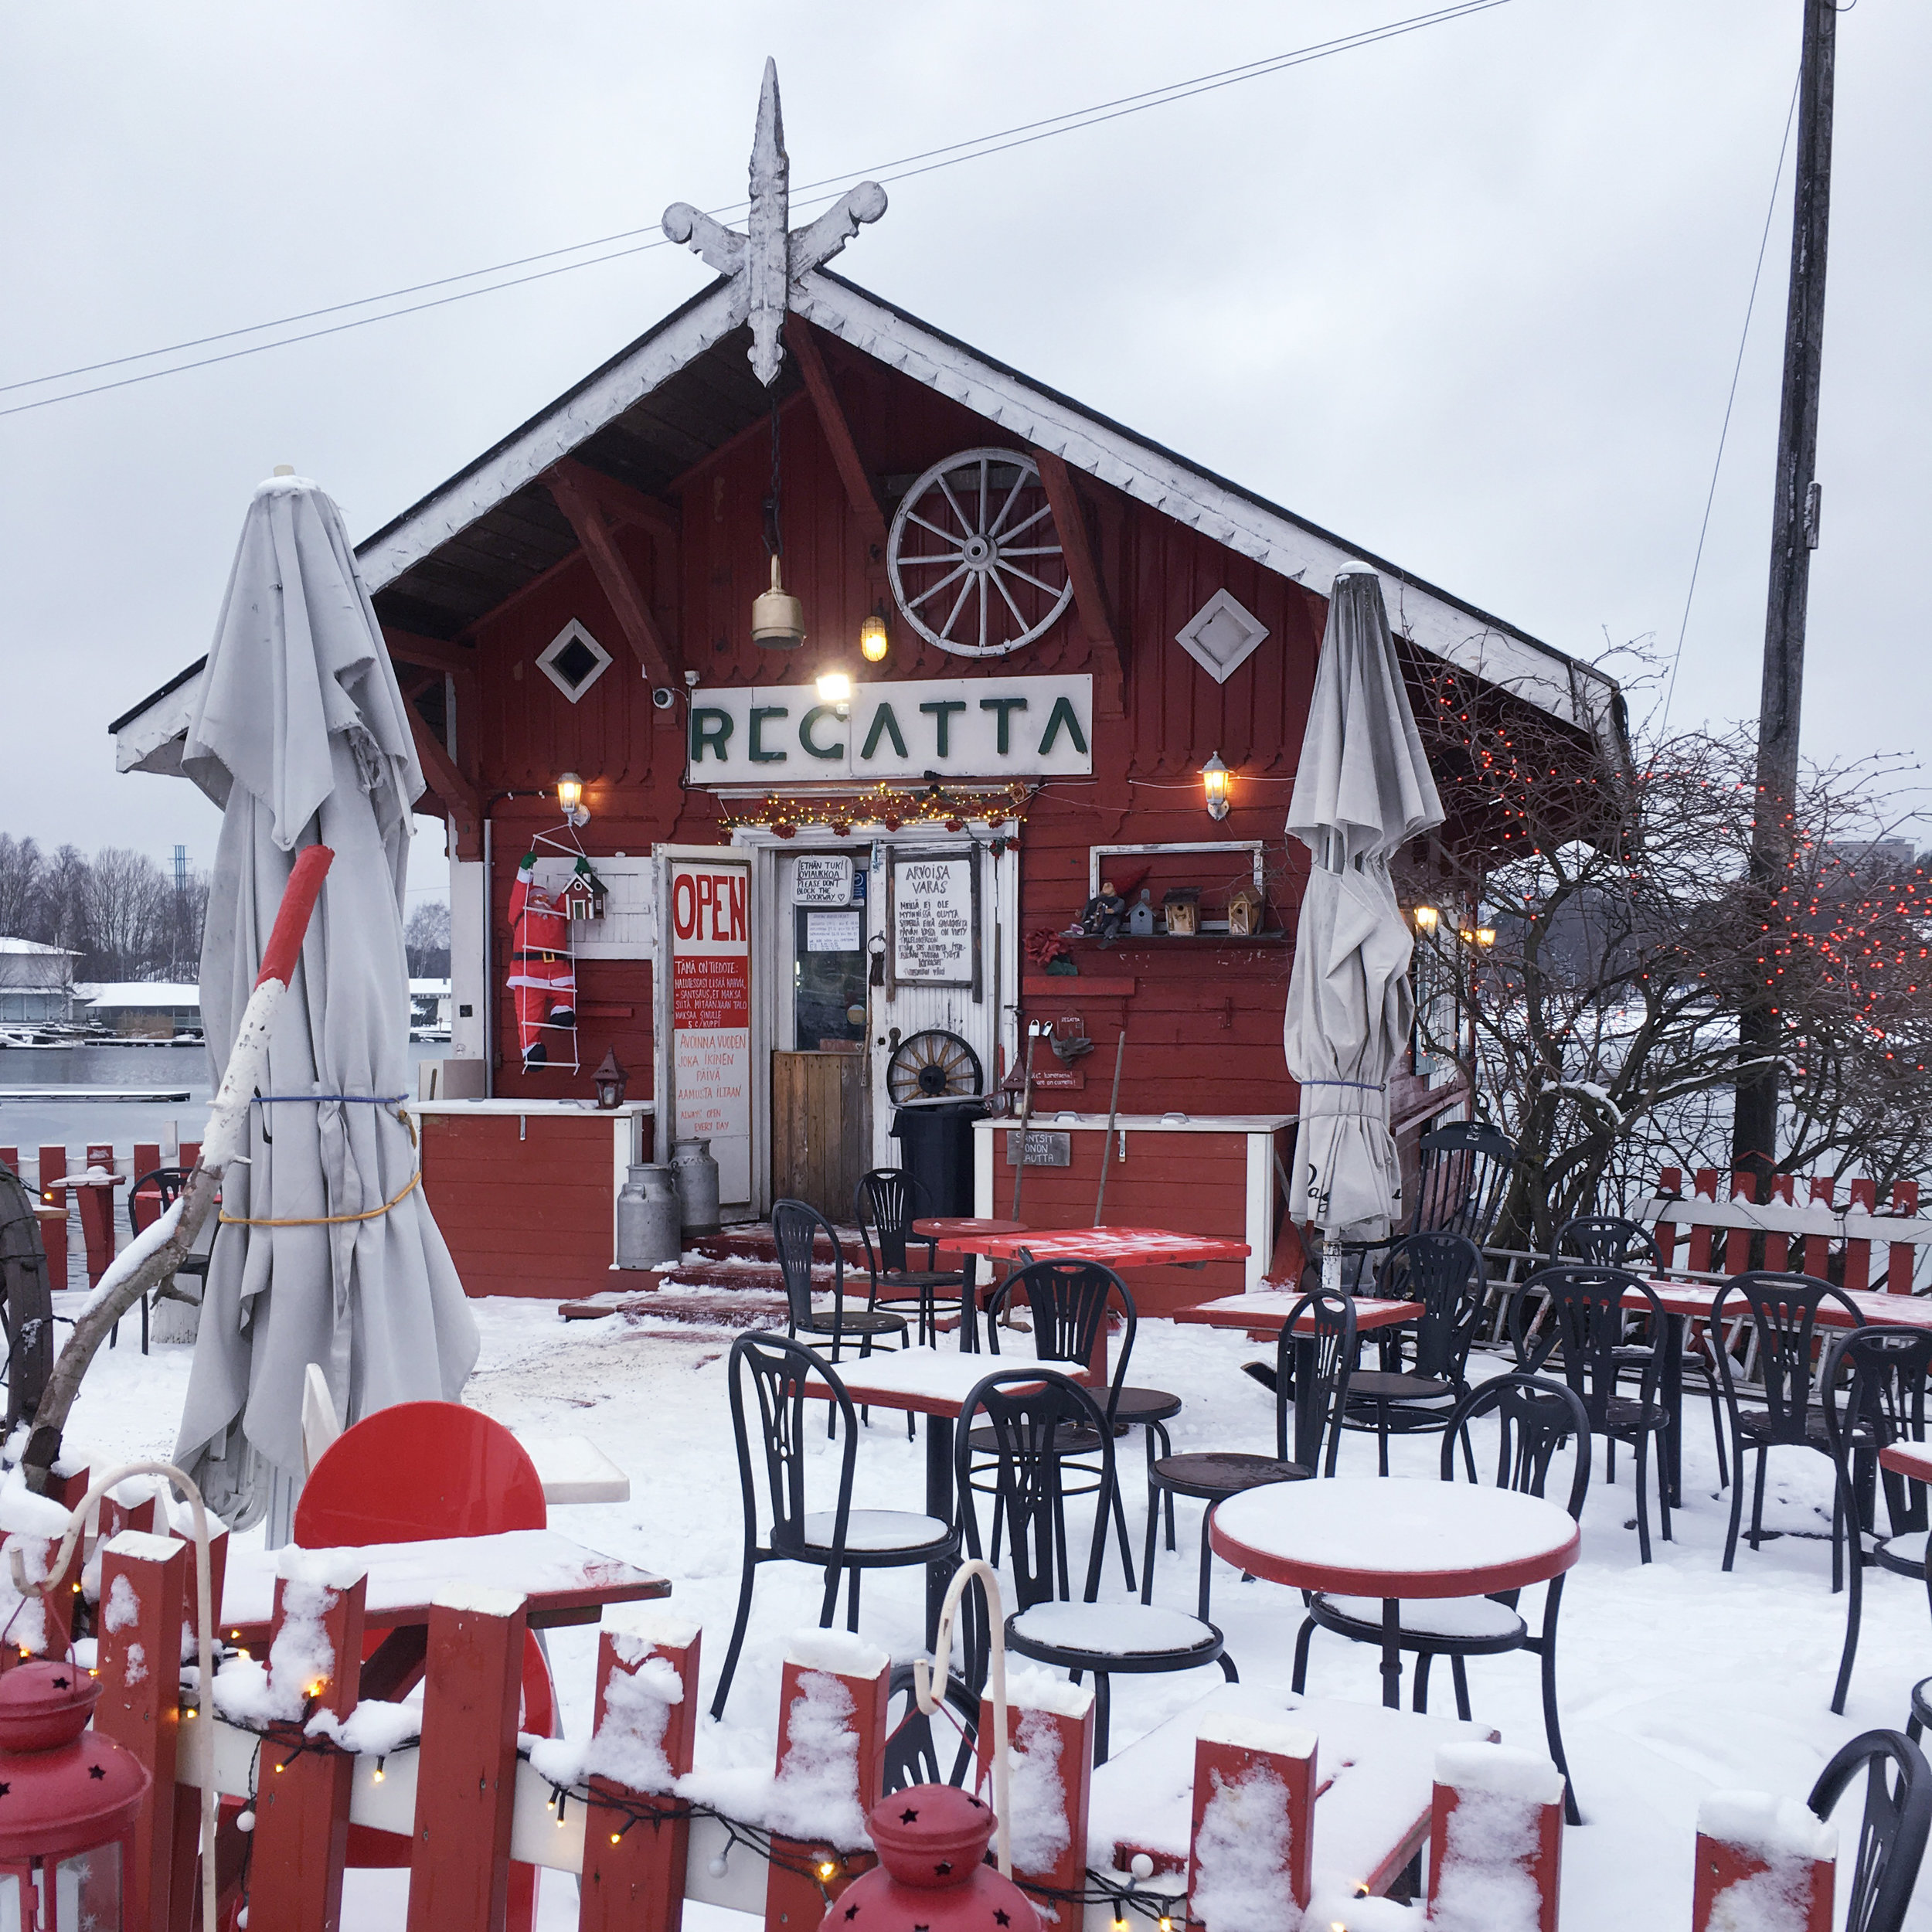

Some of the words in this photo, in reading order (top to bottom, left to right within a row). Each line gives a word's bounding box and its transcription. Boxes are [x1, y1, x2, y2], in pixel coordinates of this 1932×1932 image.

[692, 697, 1089, 762] REGATTA
[801, 860, 821, 870] ETHÄN
[799, 870, 839, 879] OVIAUKKOA
[912, 880, 947, 894] VARAS
[673, 874, 747, 941] OPEN
[937, 909, 959, 918] OLUTTA
[675, 959, 696, 975] TÄMÄ
[699, 961, 708, 974] ON
[709, 961, 738, 974] TIEDOTE:
[709, 977, 725, 988] LISÄÄ
[721, 989, 741, 999] MAKSA
[733, 1001, 747, 1009] TALO
[675, 1011, 697, 1019] MAKSAA
[700, 1010, 722, 1019] SINULLE
[688, 1020, 692, 1029] 5
[717, 1034, 746, 1049] VUODEN
[678, 1052, 699, 1067] JOKA
[696, 1067, 720, 1082] PÄIVÄ
[678, 1087, 713, 1100] AAMUSTA
[706, 1108, 721, 1118] OPEN
[695, 1121, 713, 1131] EVERY
[716, 1121, 729, 1131] DAY
[1015, 1133, 1054, 1144] SNTSIT
[1024, 1144, 1048, 1153] ONON
[1023, 1154, 1054, 1162] AUTTA
